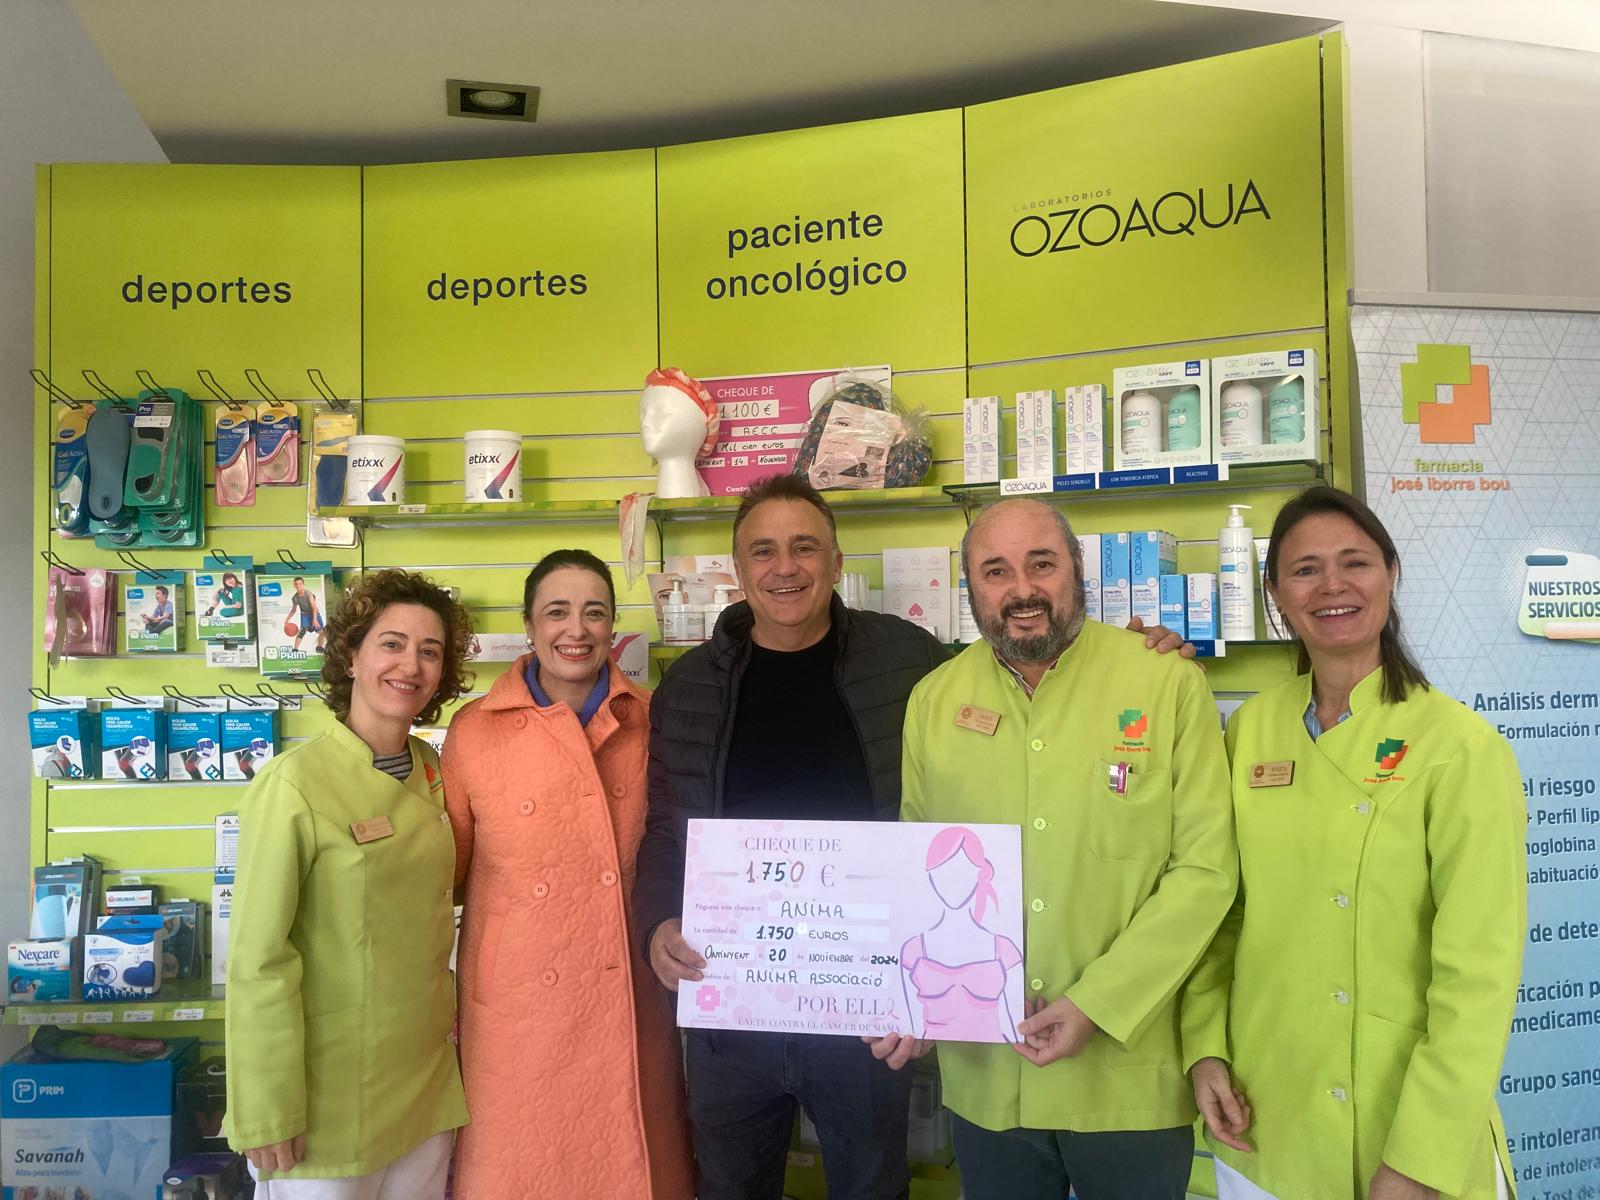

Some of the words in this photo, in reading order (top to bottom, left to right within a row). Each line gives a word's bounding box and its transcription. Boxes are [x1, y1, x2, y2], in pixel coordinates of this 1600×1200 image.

[1013, 188, 1113, 211] LABORATORIOS
[1009, 179, 1271, 258] OZOAQUA
[727, 210, 883, 258] paciente
[706, 255, 907, 300] oncológico
[121, 275, 292, 310] deportes
[427, 270, 587, 306] deportes
[717, 387, 759, 398] CHEQUE
[761, 385, 775, 395] DE
[743, 426, 778, 436] AECC
[762, 441, 785, 449] euros
[352, 456, 385, 468] etixx
[469, 452, 502, 465] etixx
[1414, 457, 1484, 473] farmacia
[1004, 482, 1047, 493] OZOAQUA
[1390, 476, 1423, 494] josé
[1479, 477, 1510, 491] bou
[1105, 538, 1113, 578] OZOAQUA
[1528, 581, 1600, 596] NUESTROS
[1528, 601, 1600, 619] SERVICIOS
[280, 650, 306, 661] PRIM
[1473, 691, 1545, 712] Análisis
[1497, 721, 1590, 740] Formulación
[1539, 777, 1596, 798] riesgo
[1537, 807, 1577, 825] Perfil
[744, 837, 814, 854] CHEQUE
[818, 838, 841, 852] DE
[1526, 864, 1599, 884] abituació
[734, 904, 755, 912] cheque
[756, 925, 794, 941] 1.750
[808, 929, 849, 941] EUROS
[1529, 923, 1553, 944] de
[18, 949, 59, 962] Nexcare
[769, 948, 787, 962] 20
[870, 955, 899, 966] 2024
[797, 996, 838, 1014] POR
[39, 1086, 65, 1096] PRIM
[1499, 1074, 1557, 1095] Grupo
[14, 1147, 85, 1164] Savanah
[1523, 1164, 1542, 1181] de
